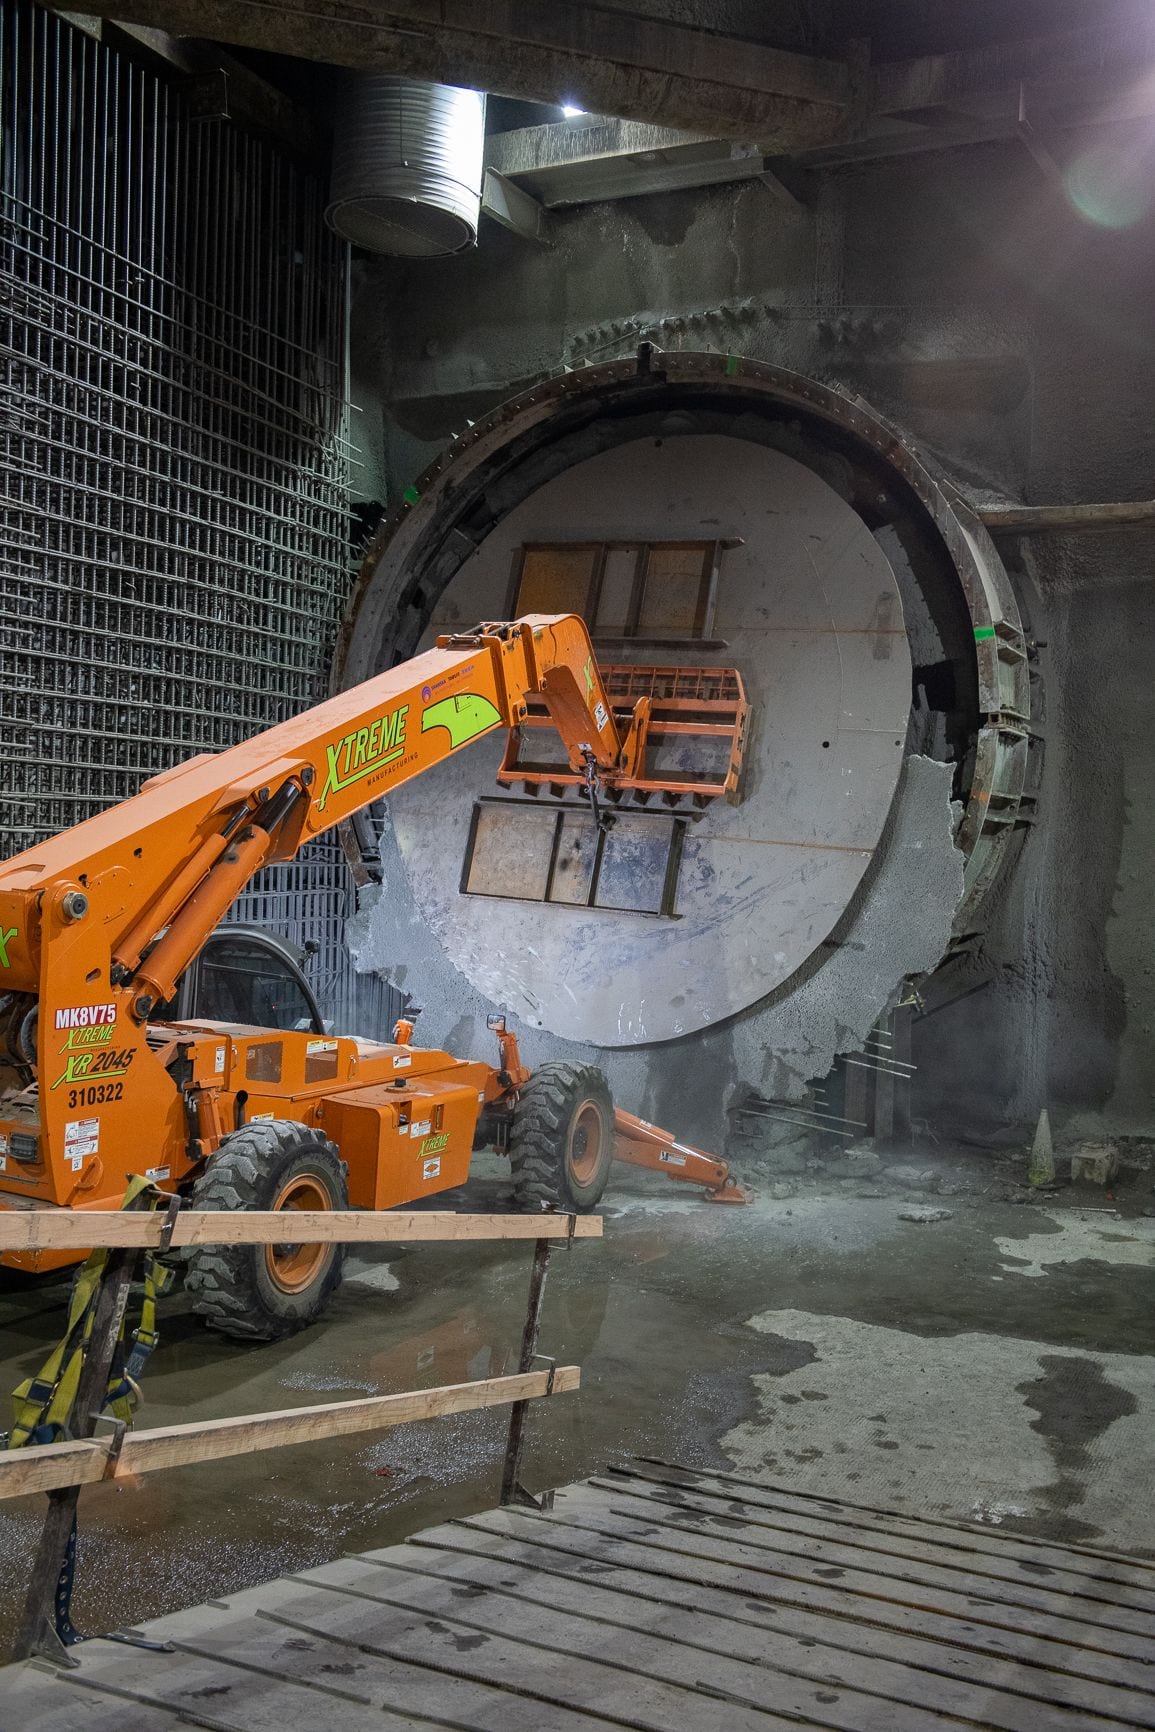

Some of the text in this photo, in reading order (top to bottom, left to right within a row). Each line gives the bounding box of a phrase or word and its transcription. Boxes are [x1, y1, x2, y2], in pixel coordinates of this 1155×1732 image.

[318, 704, 409, 812] XTREME
[367, 752, 419, 786] MANUFACTURING
[56, 1004, 116, 1029] MK8V75
[58, 1024, 117, 1055] XTREME
[90, 1048, 137, 1072] 2045
[68, 1082, 124, 1109] 310322
[416, 1132, 450, 1161] XTREME
